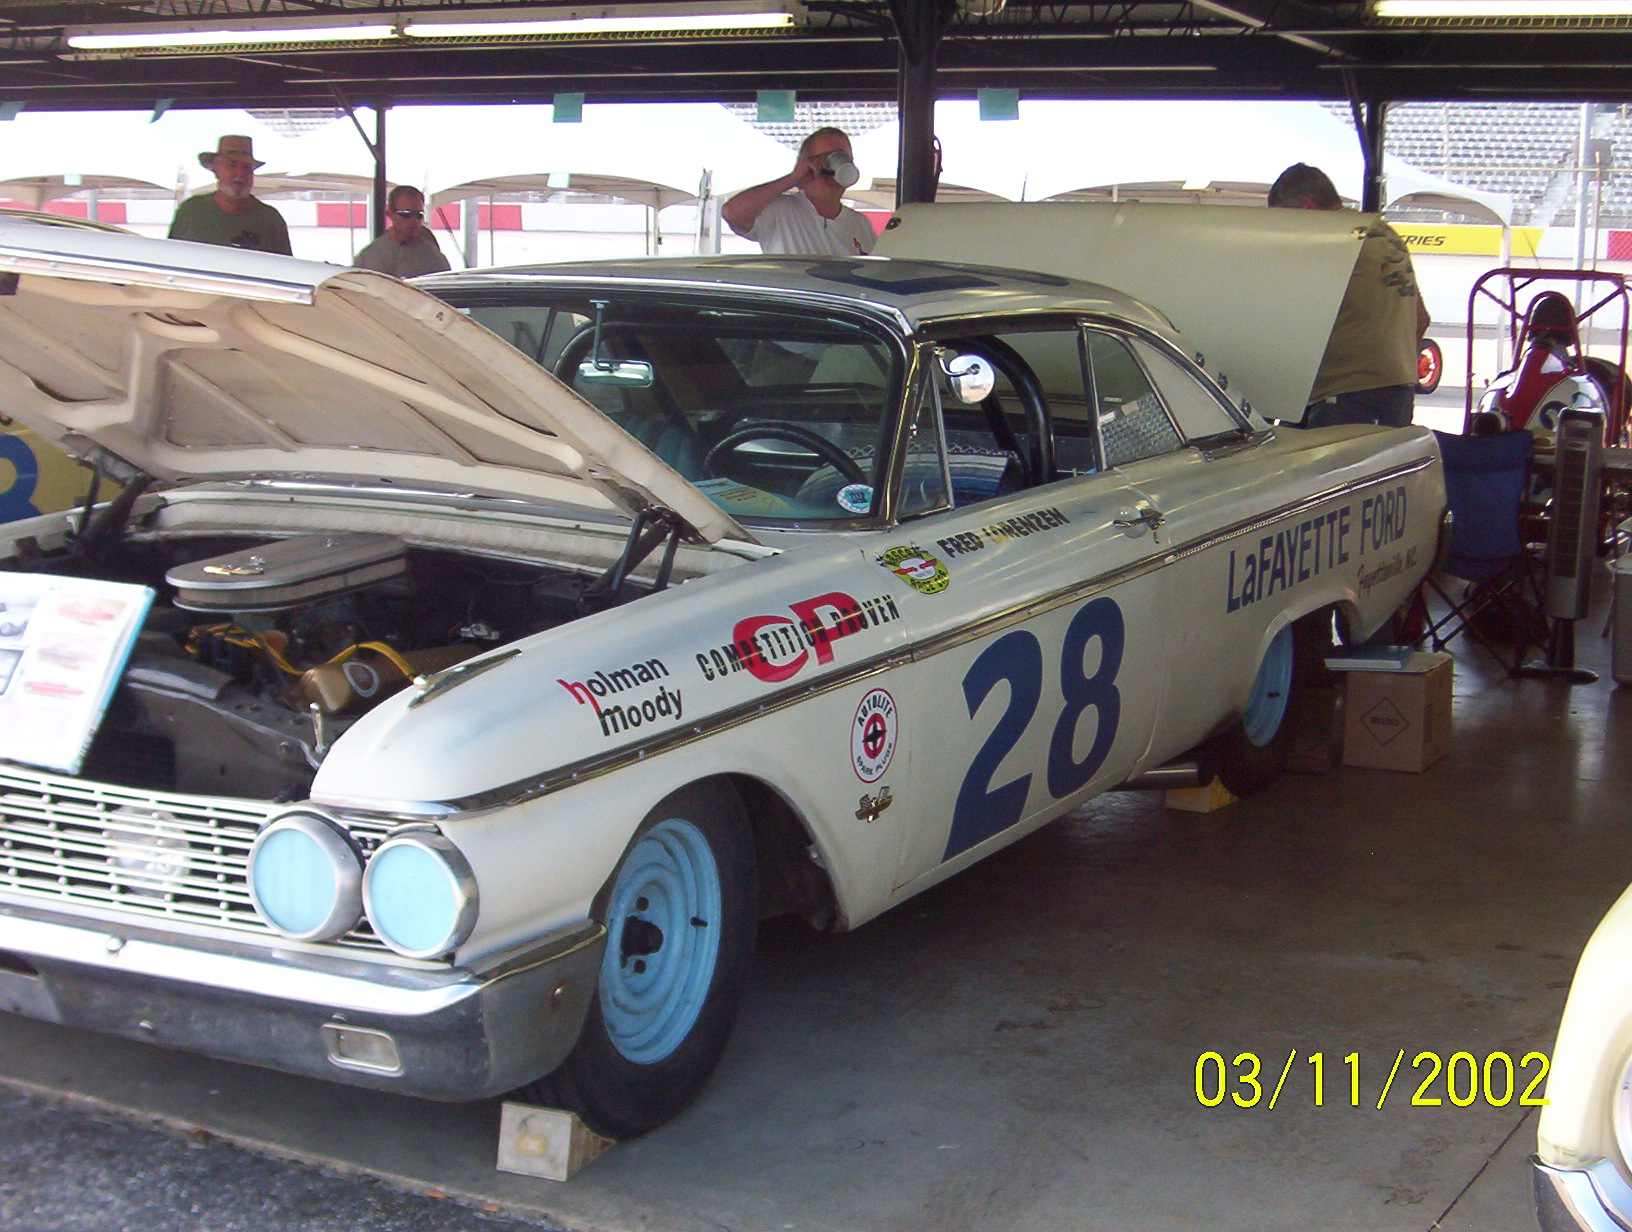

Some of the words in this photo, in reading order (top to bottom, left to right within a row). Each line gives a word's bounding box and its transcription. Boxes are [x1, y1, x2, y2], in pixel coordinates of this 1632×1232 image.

[1399, 235, 1447, 246] RIES
[936, 531, 985, 559] FRED
[1226, 506, 1350, 614] LaFAYETTE
[1360, 486, 1407, 556] FORD
[696, 617, 829, 681] COMPETITION
[829, 594, 900, 637] PROVEN
[556, 658, 670, 712] holman
[597, 685, 682, 737] moody
[857, 695, 893, 727] AUTOLITE
[941, 597, 1125, 862] 28
[856, 755, 874, 775] SPARK
